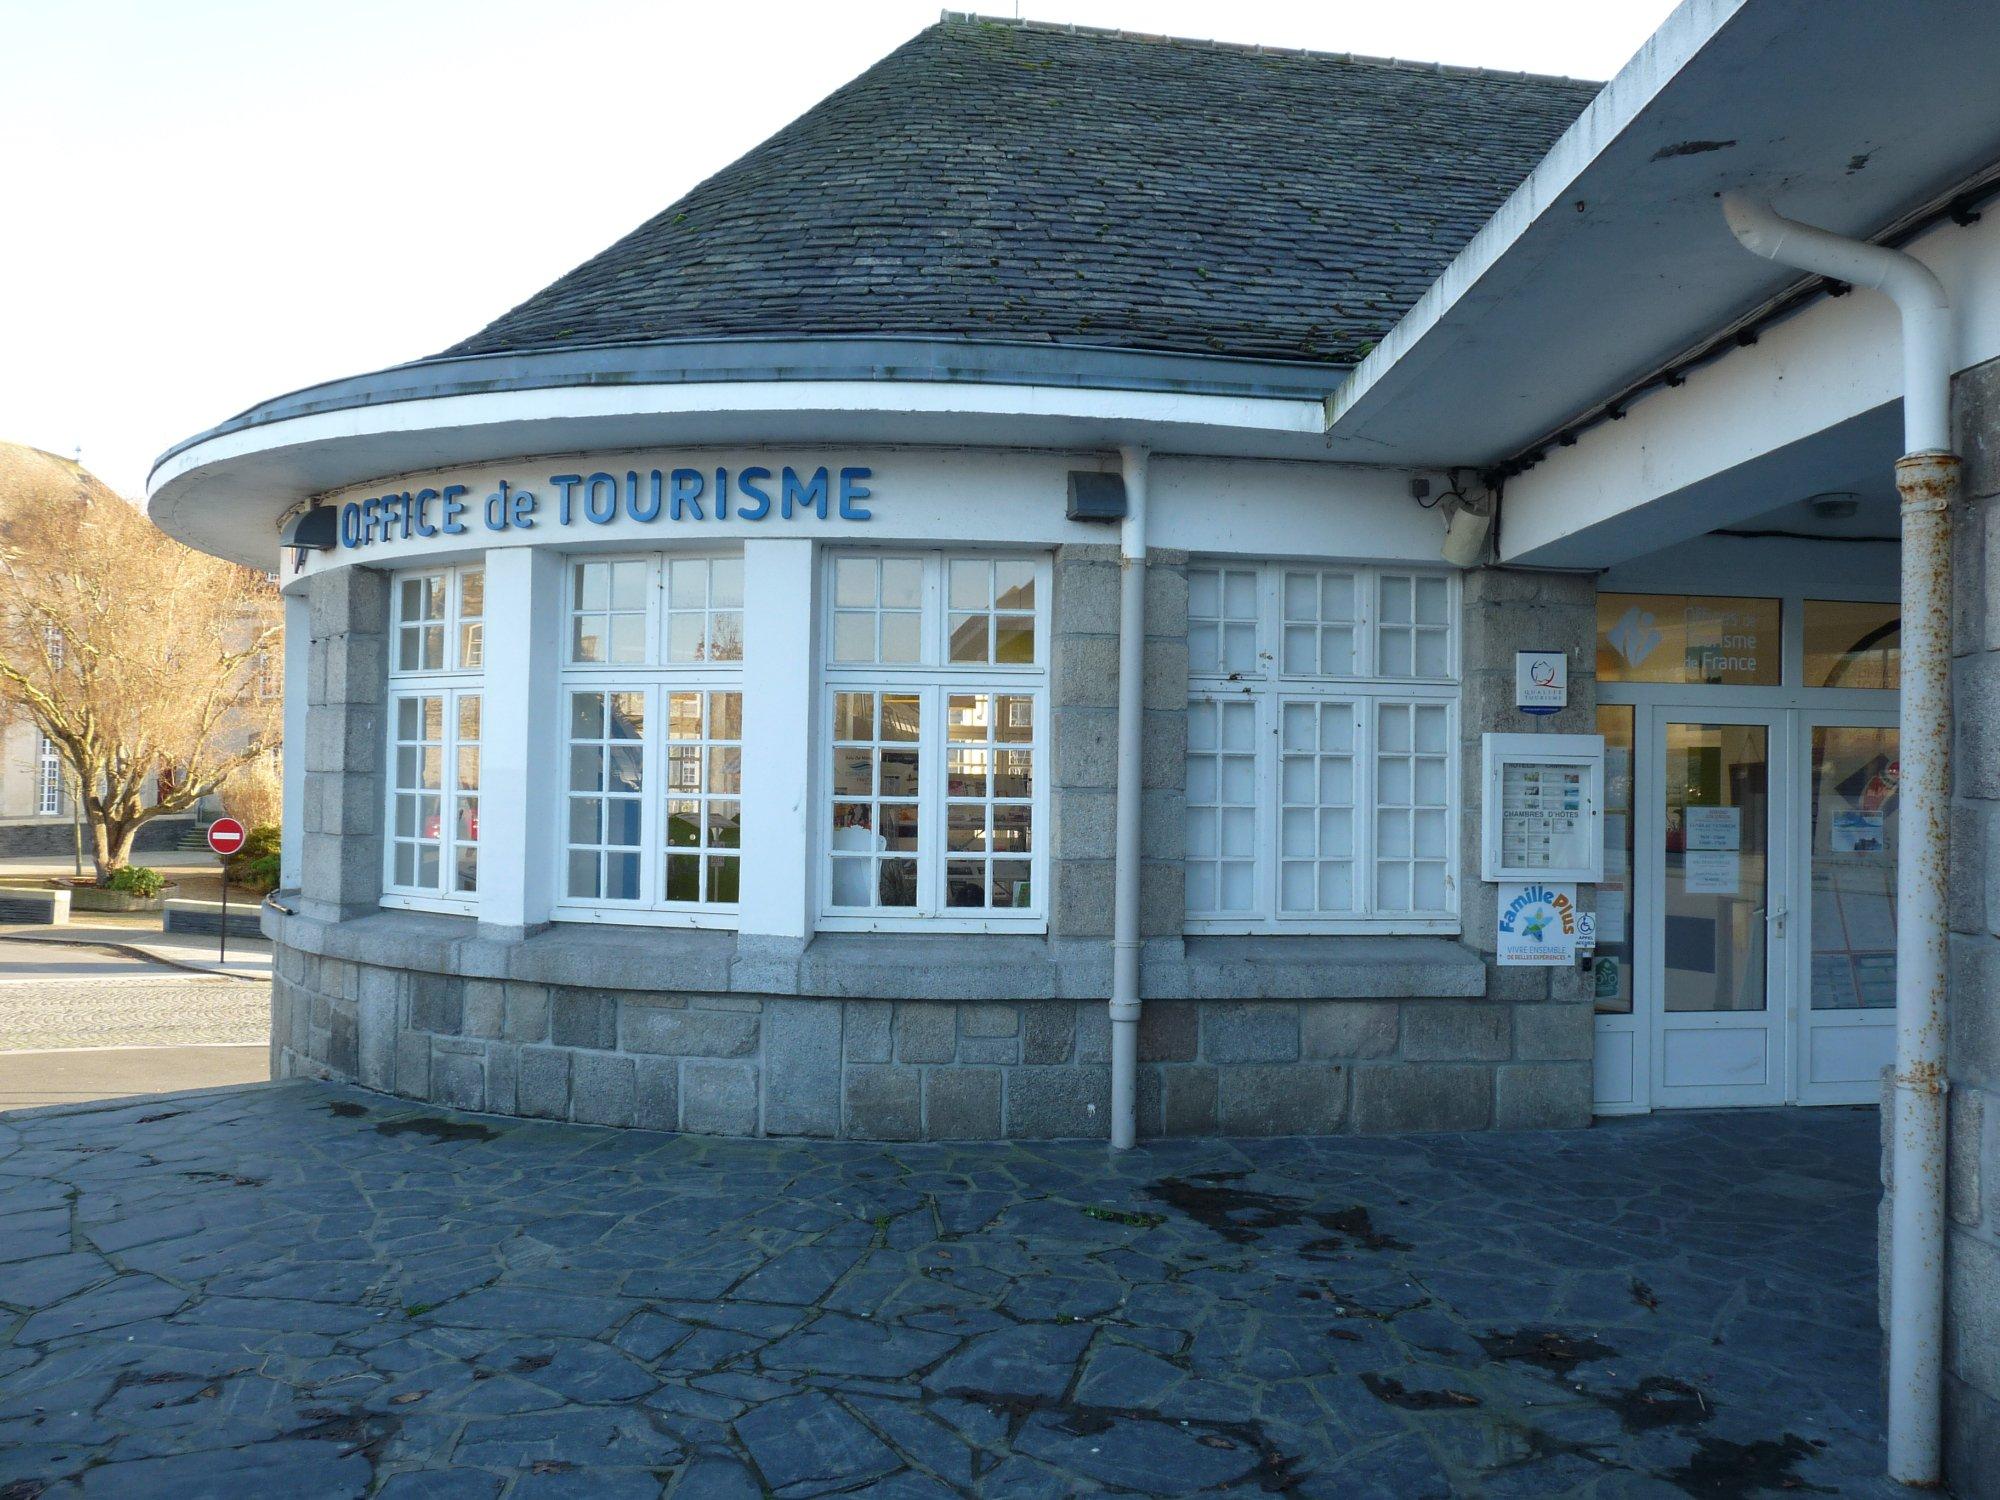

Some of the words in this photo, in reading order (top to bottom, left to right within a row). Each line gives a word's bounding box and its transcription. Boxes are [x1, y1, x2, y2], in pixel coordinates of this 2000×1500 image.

[342, 484, 467, 549] OFFICE
[484, 480, 536, 531] de
[550, 466, 872, 526] TOURISME
[1702, 652, 1758, 672] France
[1503, 810, 1544, 818] CHAMBRES
[1499, 886, 1555, 933] Famille
[1552, 893, 1575, 935] Plus
[1507, 946, 1528, 954] VIVRE
[1530, 946, 1567, 954] ENSEMBLE
